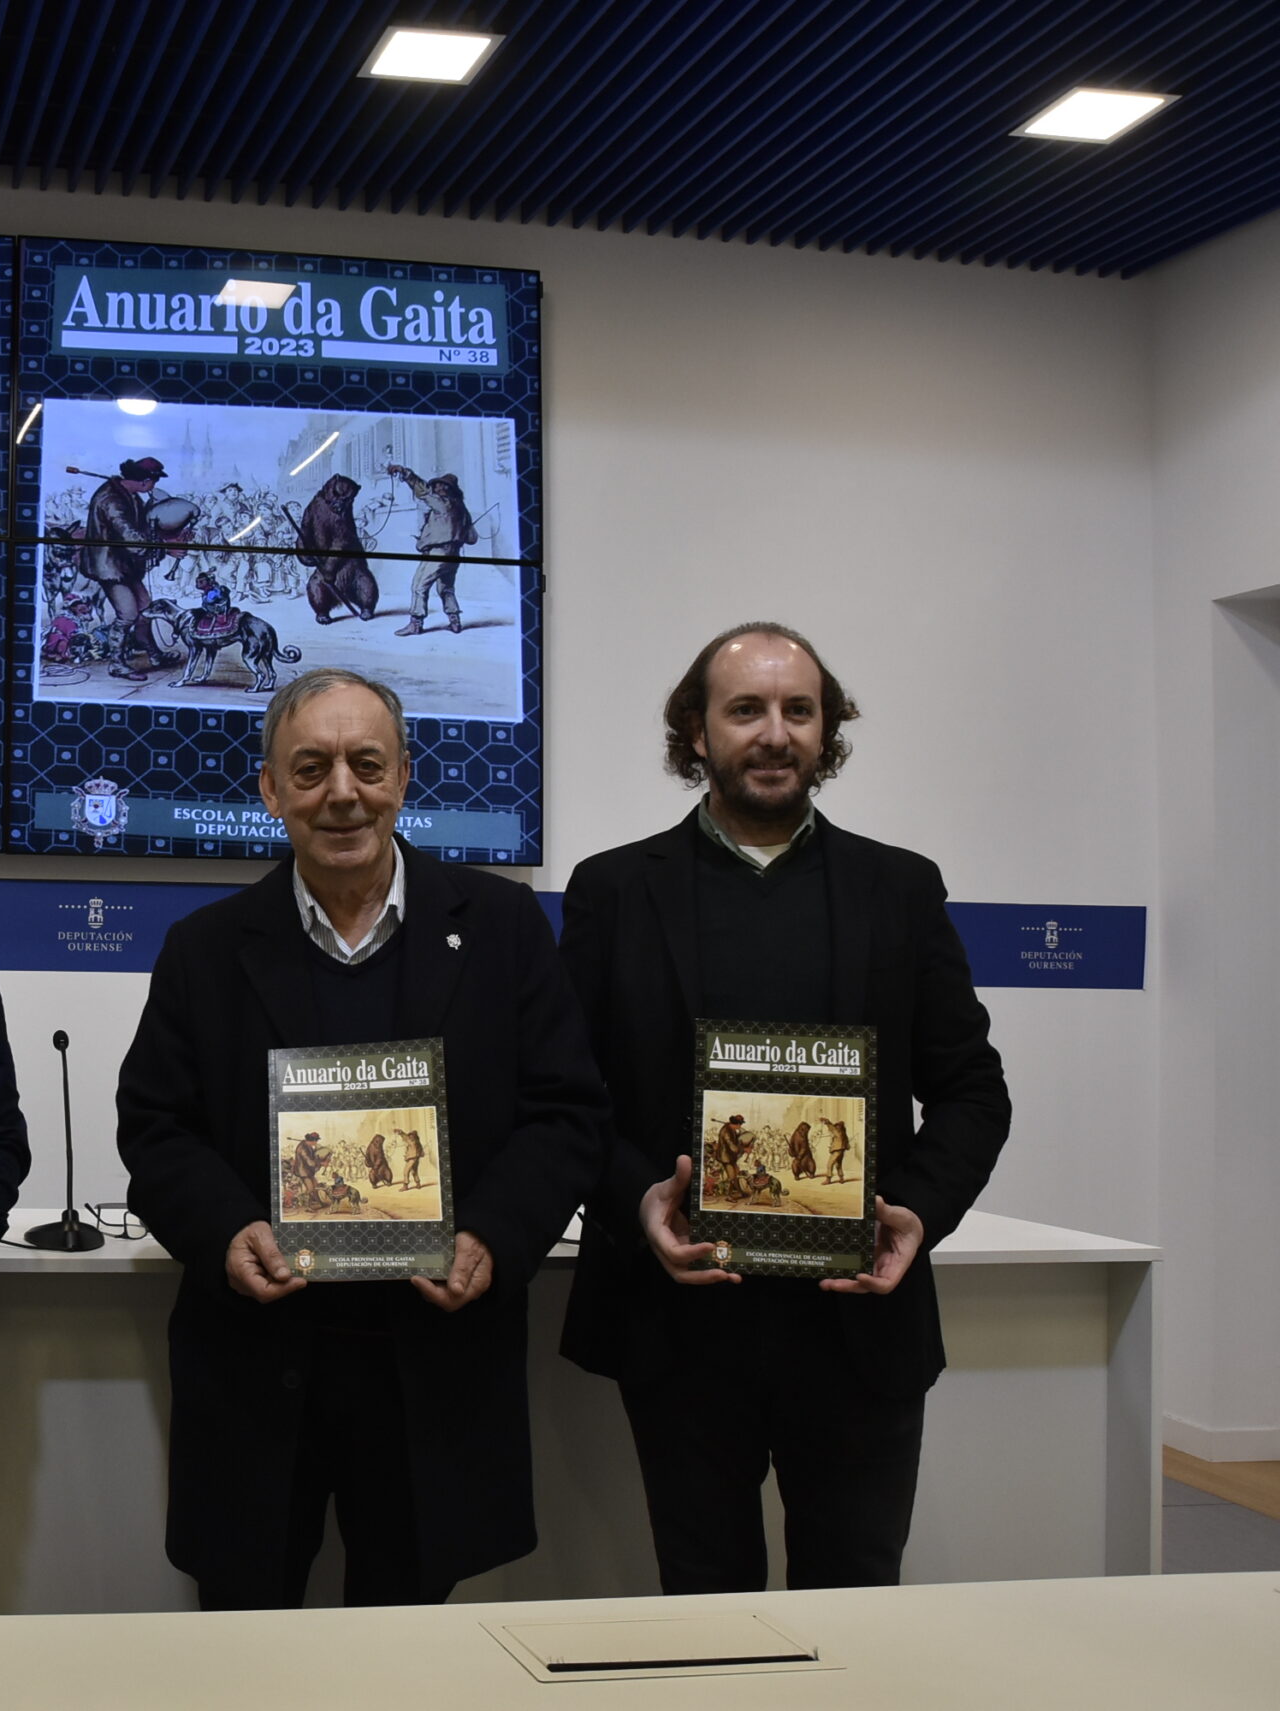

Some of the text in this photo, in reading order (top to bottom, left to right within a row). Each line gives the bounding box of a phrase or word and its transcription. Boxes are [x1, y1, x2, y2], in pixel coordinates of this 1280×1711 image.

[62, 275, 497, 345] Anuario da Gaita
[244, 337, 315, 357] 2023
[468, 350, 490, 364] 38
[173, 807, 236, 823] ESCOLA
[194, 822, 288, 838] DEPUTACIÓ
[58, 931, 133, 942] DEPUTACIÓN
[67, 942, 123, 953] OURENSE
[1021, 950, 1083, 960] DEPUTACIÓN
[1028, 961, 1075, 970] OURENSE
[709, 1036, 861, 1066] Anuario da Gaita
[283, 1055, 429, 1084] Anuario da Gaita
[772, 1064, 797, 1073] 2023
[344, 1082, 368, 1090] 2023
[768, 1252, 801, 1260] PROVINCIAL
